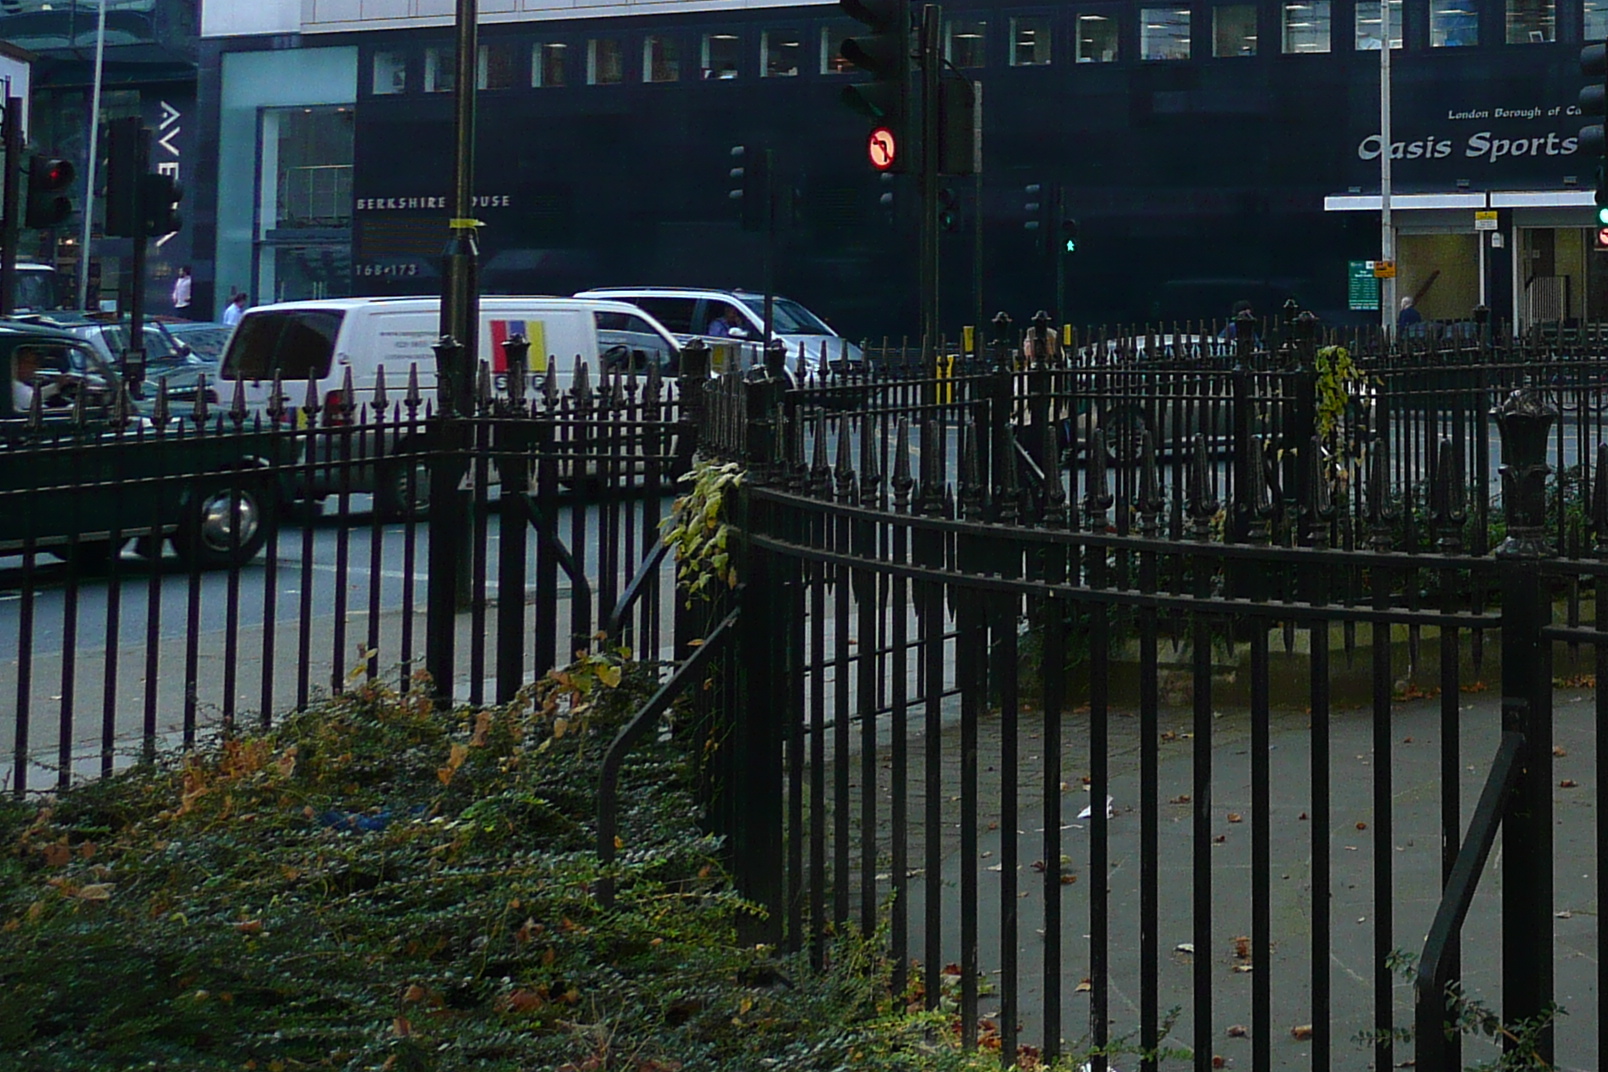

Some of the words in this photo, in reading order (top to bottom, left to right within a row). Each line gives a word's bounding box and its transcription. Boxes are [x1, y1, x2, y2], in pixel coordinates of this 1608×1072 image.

[1447, 109, 1489, 120] London
[1494, 106, 1542, 119] Borough
[1548, 106, 1561, 116] of
[1358, 134, 1452, 160] Oasis
[1465, 131, 1579, 163] Sports
[156, 101, 181, 247] AVE
[356, 196, 446, 210] BERKSHIRE
